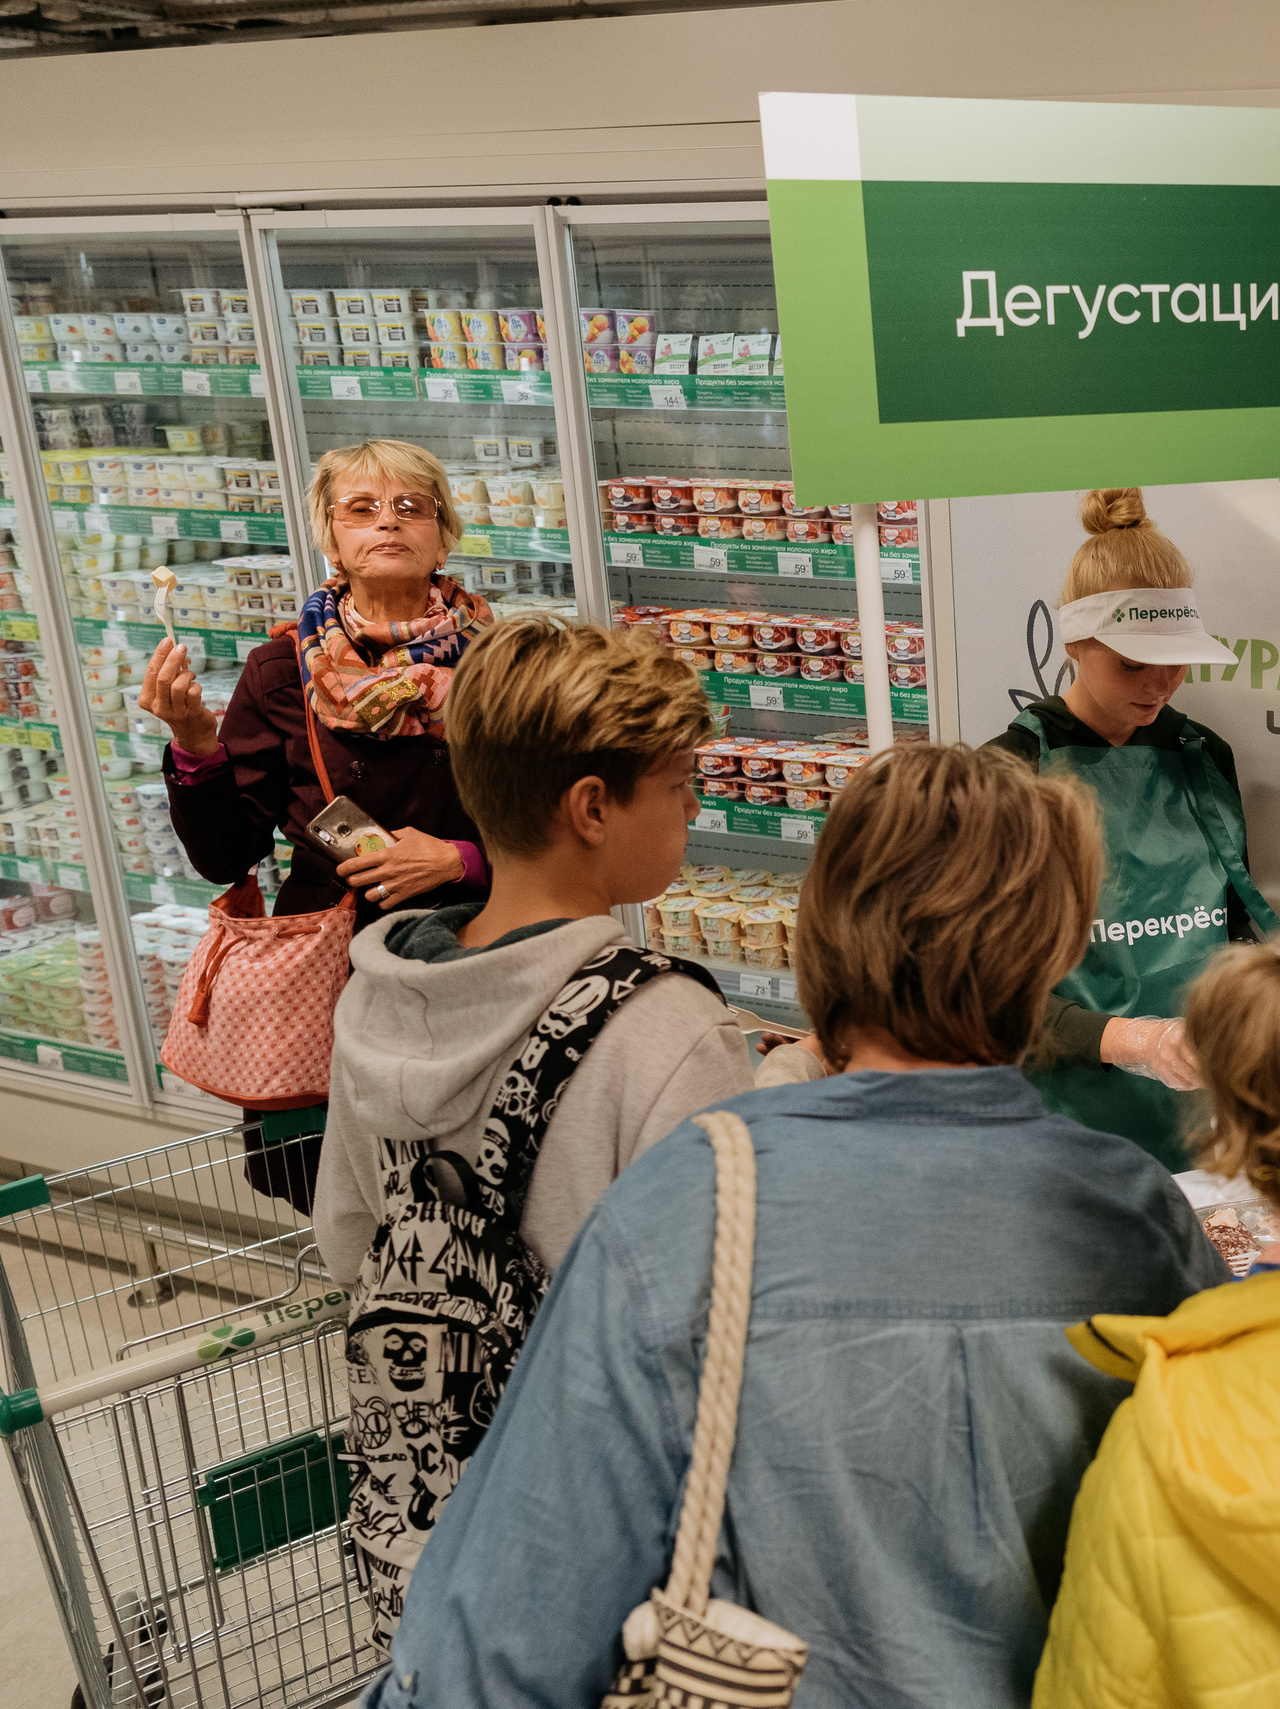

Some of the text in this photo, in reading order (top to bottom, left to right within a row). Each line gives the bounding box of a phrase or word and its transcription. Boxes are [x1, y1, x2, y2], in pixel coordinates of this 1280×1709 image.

[740, 543, 751, 551] без
[752, 544, 786, 552] заменителя
[787, 546, 819, 554] молочного
[820, 548, 837, 556] жира
[724, 676, 848, 694] Продукты без заменителя молочного жира
[262, 1290, 351, 1328] Пере
